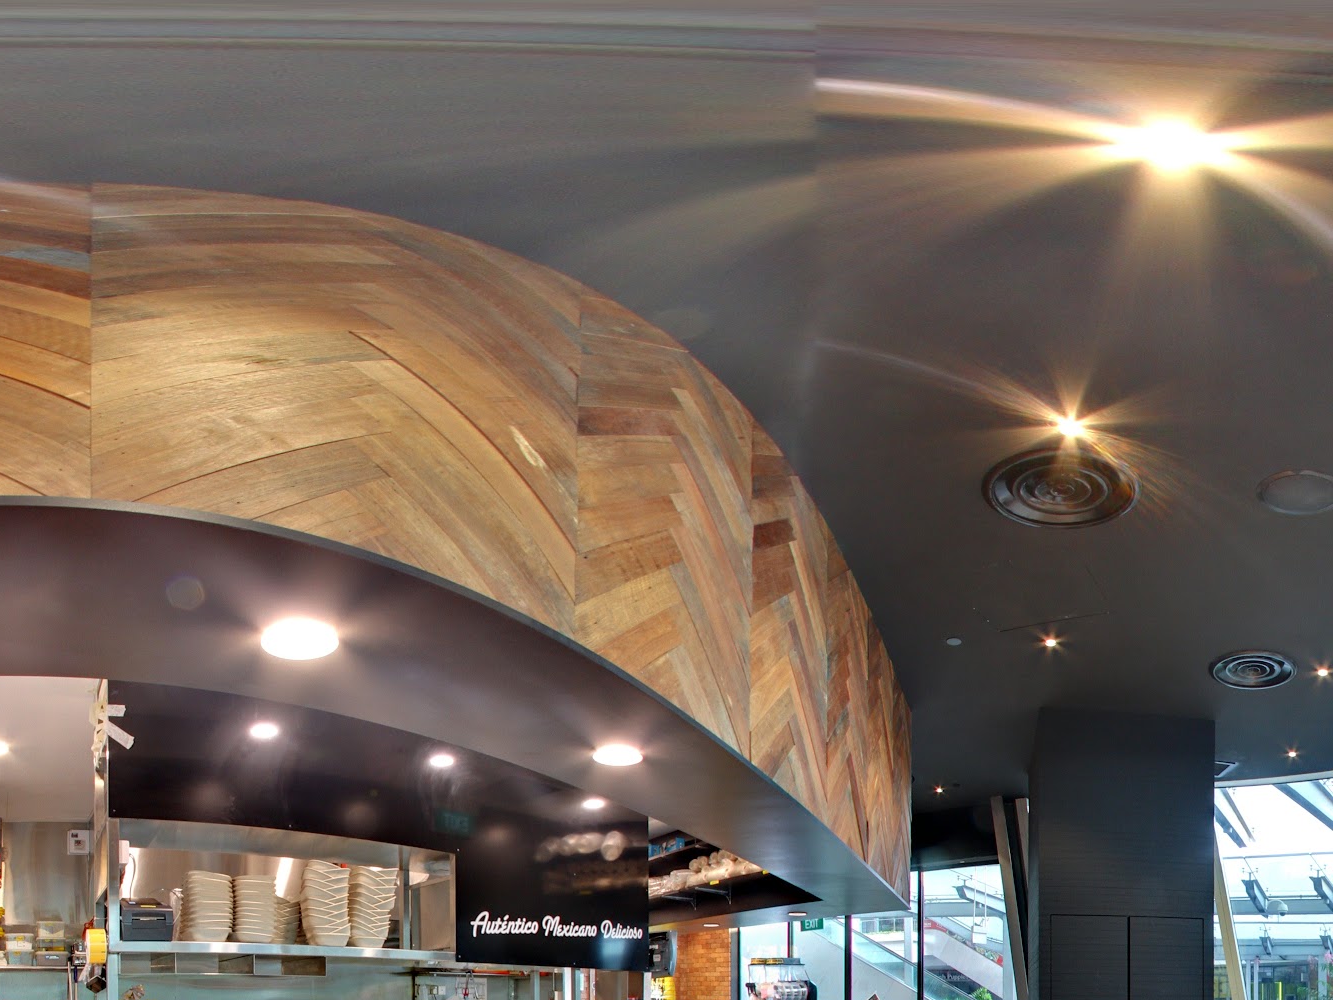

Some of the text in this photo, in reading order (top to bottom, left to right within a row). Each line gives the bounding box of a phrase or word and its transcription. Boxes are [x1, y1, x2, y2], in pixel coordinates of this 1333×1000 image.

[470, 911, 643, 940] Auténtico Mexicano Delicioso
[805, 918, 819, 929] EXIT
